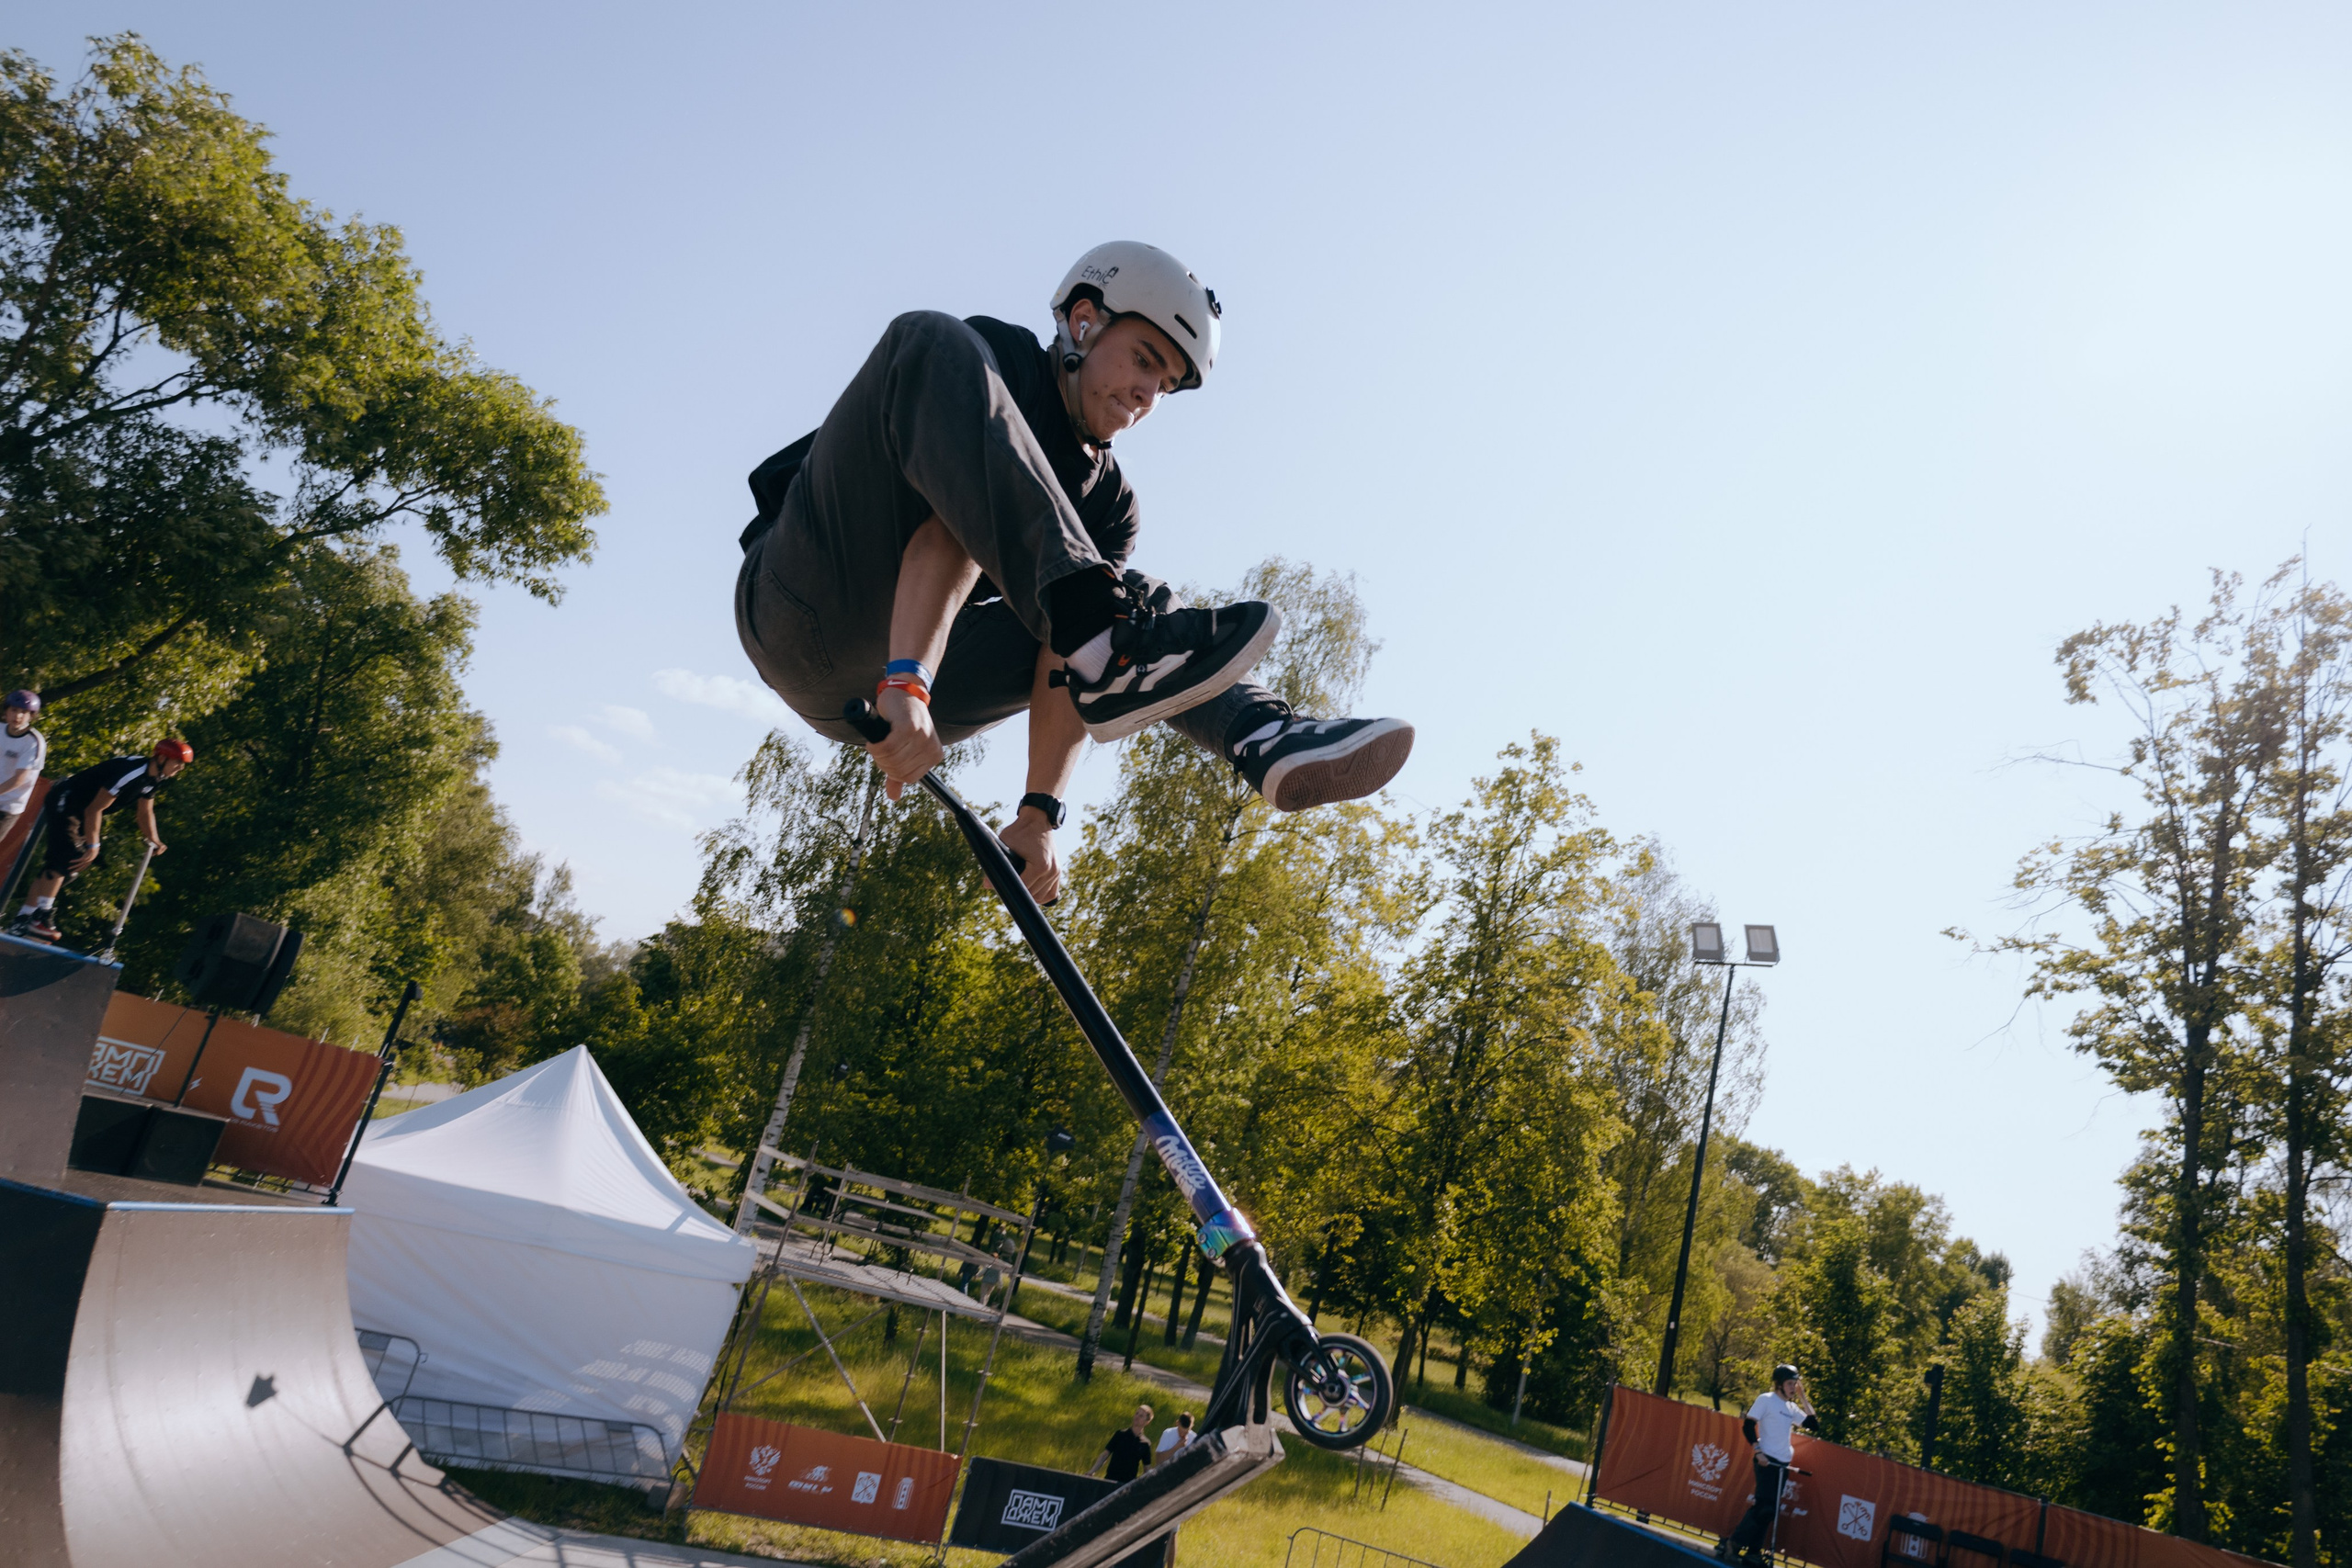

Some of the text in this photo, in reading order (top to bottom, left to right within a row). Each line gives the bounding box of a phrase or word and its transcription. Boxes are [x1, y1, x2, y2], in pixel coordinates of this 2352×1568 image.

[1081, 265, 1114, 285] Ethic
[1012, 1494, 1060, 1516] ПАМП
[1006, 1507, 1056, 1527] ДЖЕМ
